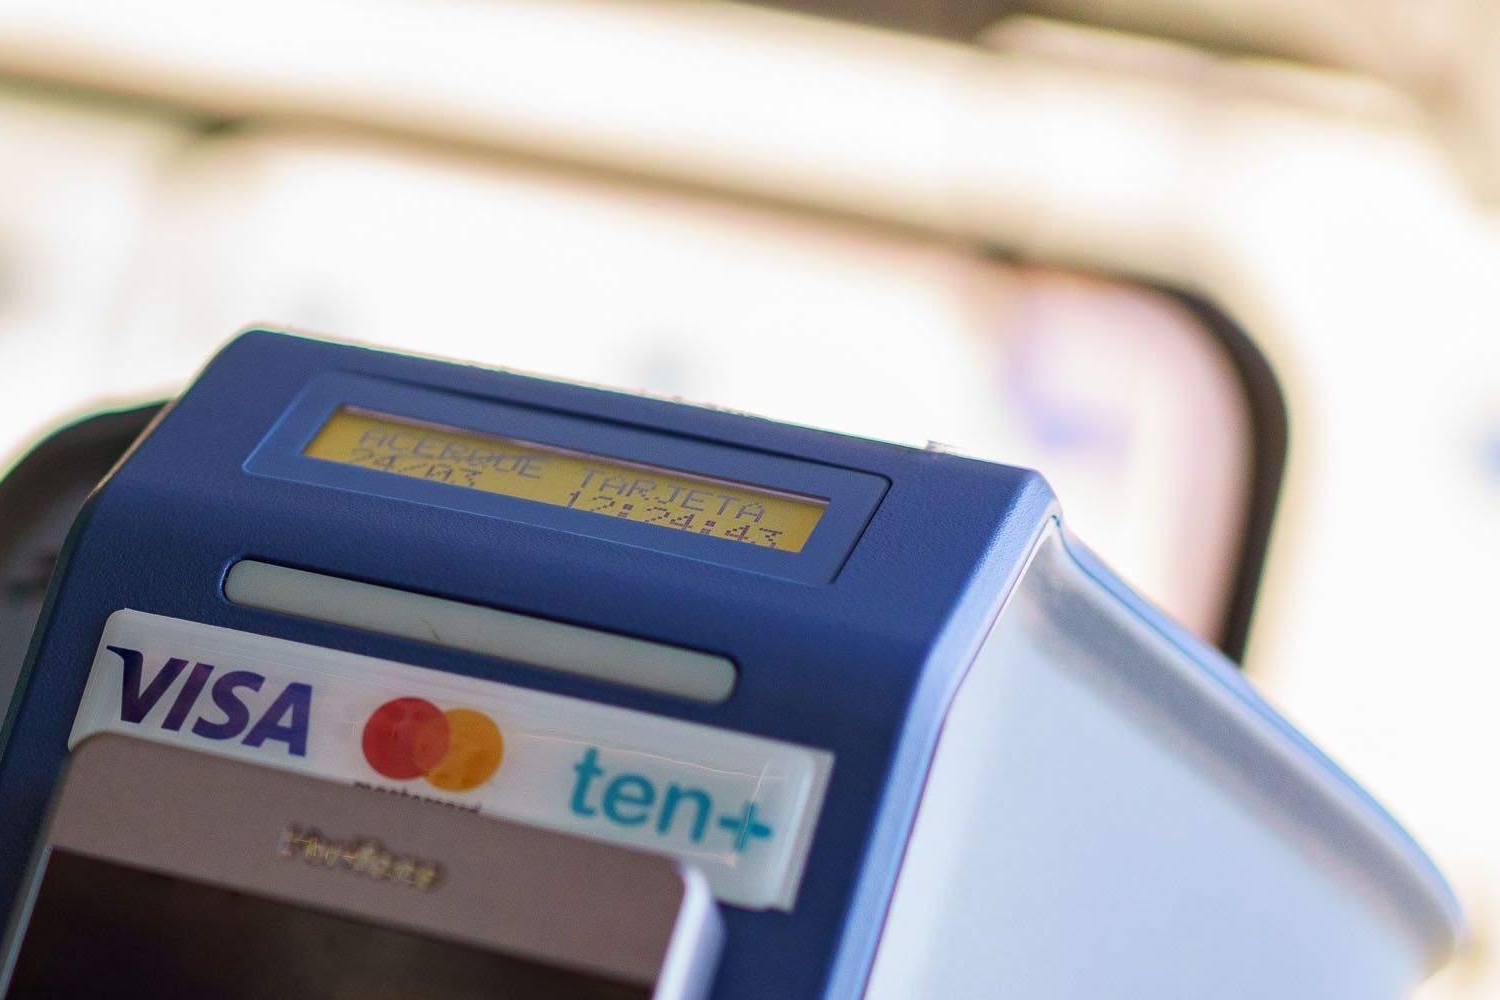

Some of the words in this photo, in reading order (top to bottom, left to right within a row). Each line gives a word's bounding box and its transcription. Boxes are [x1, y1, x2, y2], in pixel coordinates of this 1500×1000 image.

[579, 468, 766, 523] TARJETA
[106, 645, 314, 758] VISA
[567, 746, 773, 852] ten+
